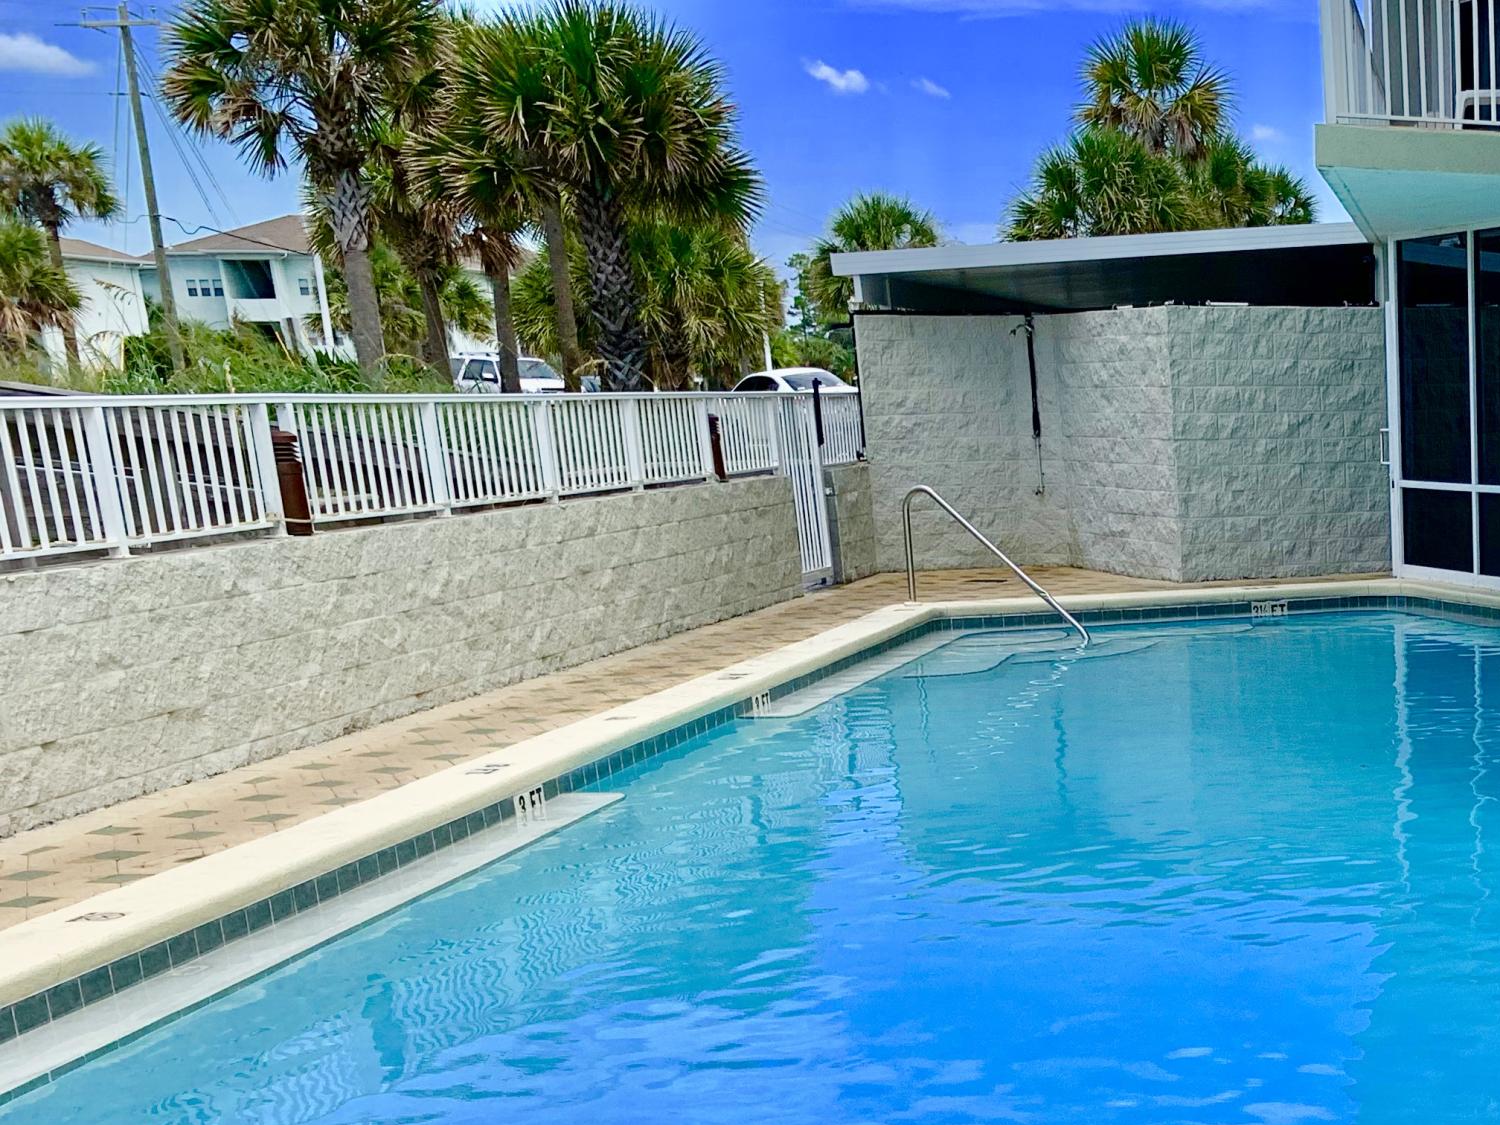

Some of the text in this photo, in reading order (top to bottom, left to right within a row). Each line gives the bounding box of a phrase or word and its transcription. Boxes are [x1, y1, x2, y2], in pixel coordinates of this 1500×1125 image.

[1270, 603, 1286, 613] FT
[761, 692, 769, 707] FT
[518, 786, 543, 814] 3 FT
